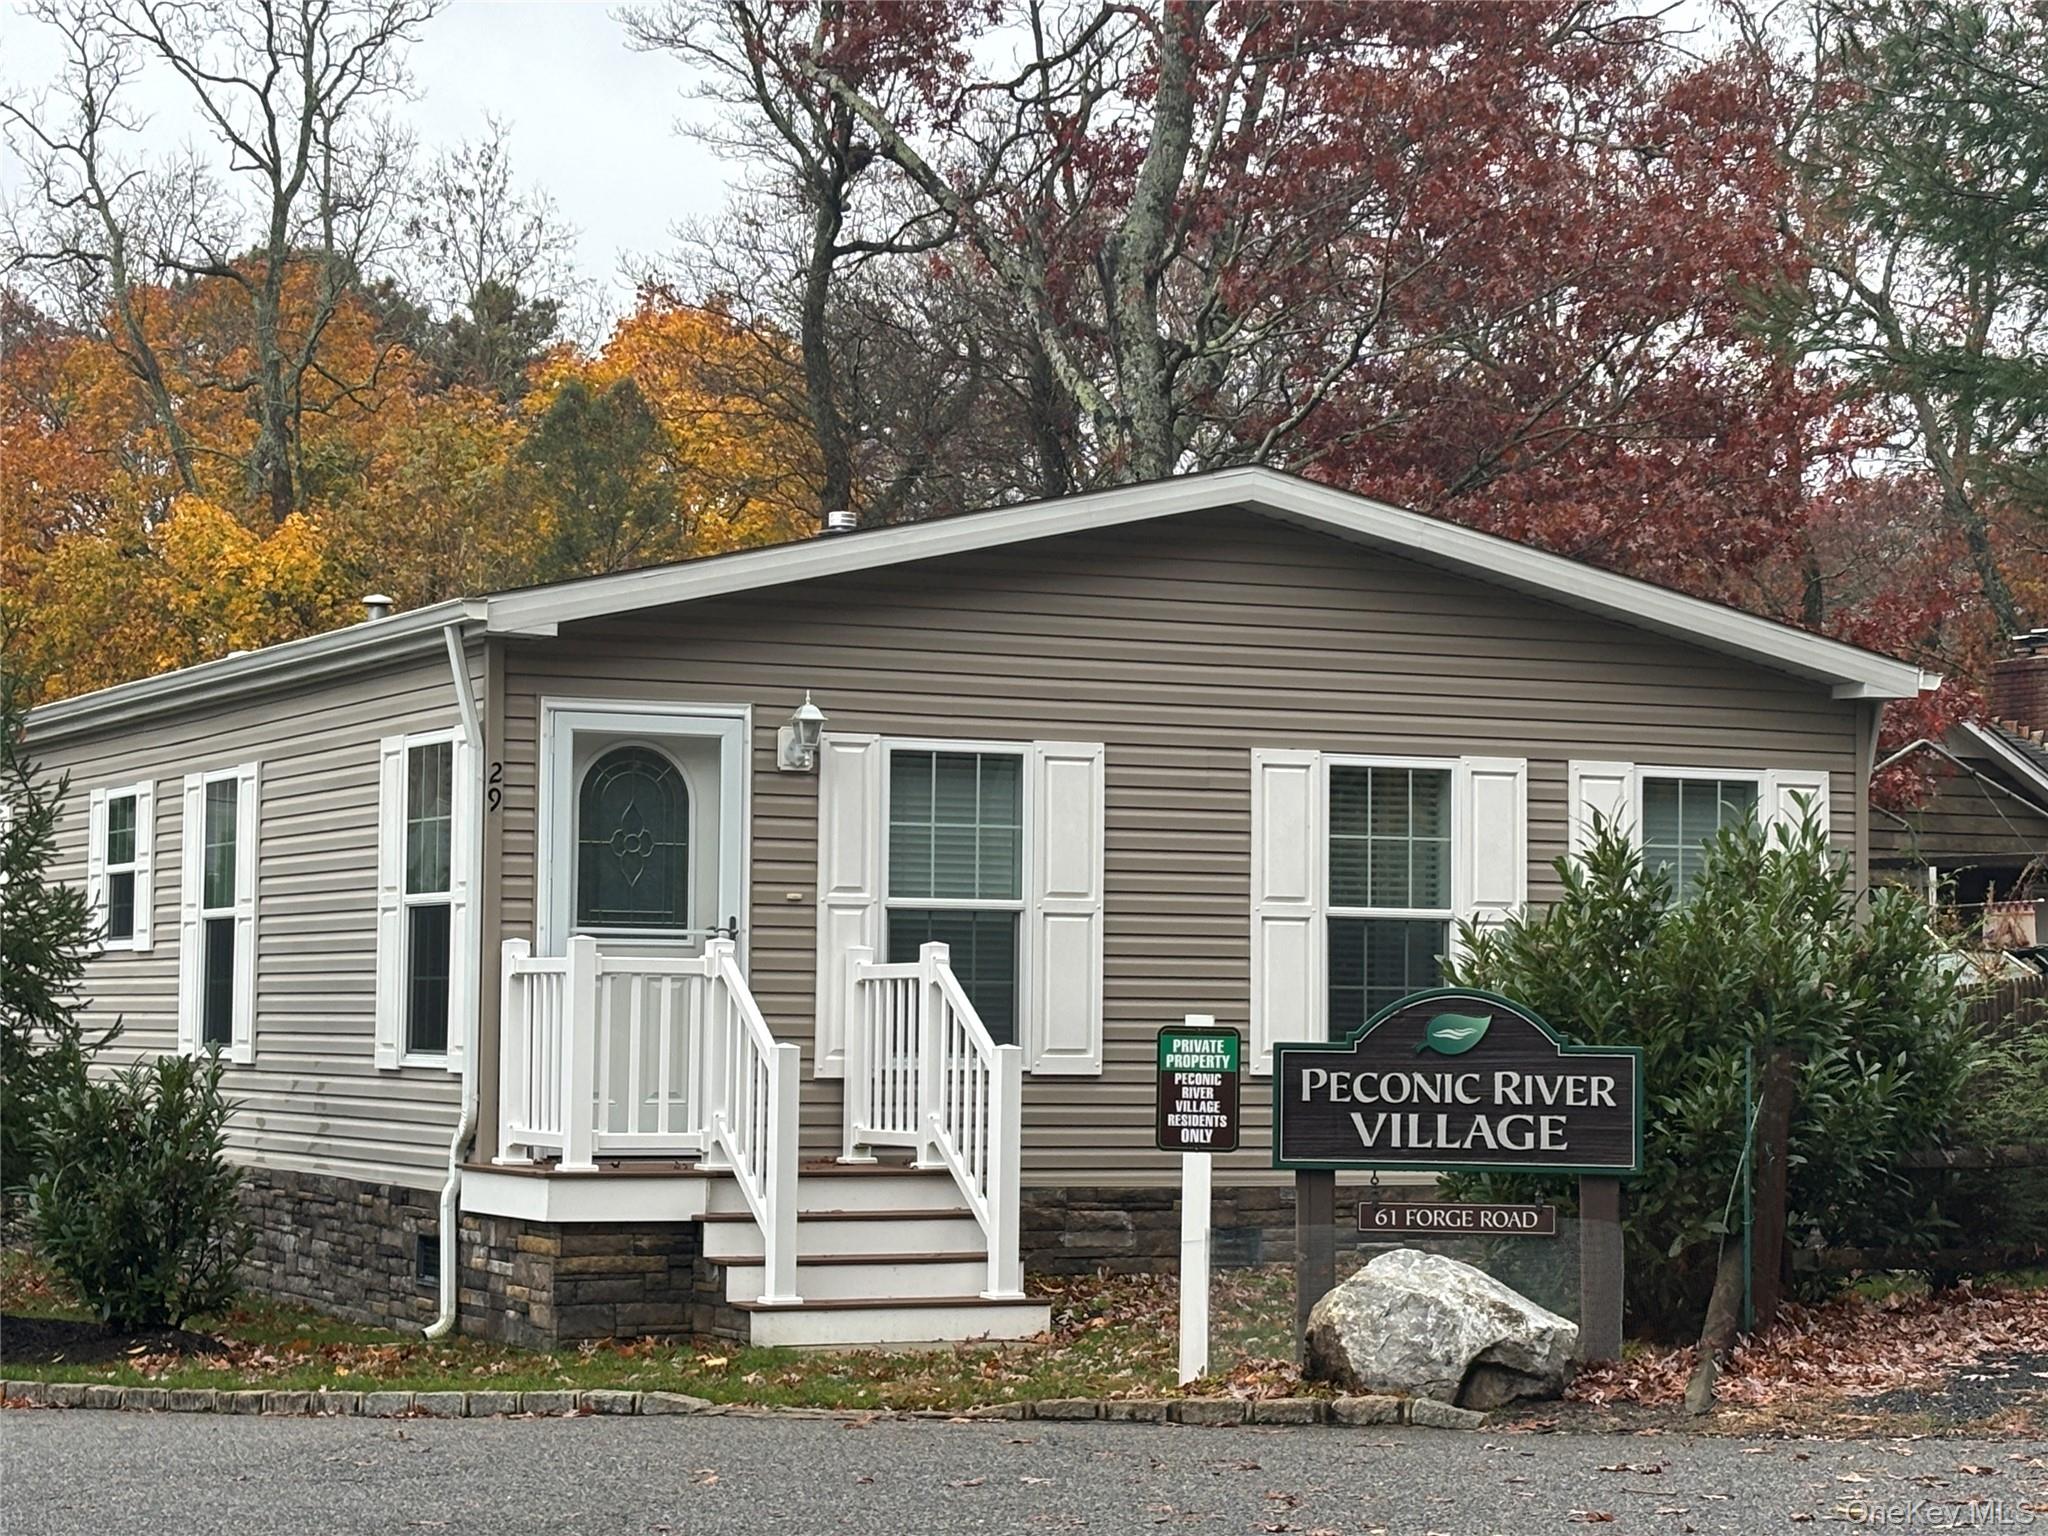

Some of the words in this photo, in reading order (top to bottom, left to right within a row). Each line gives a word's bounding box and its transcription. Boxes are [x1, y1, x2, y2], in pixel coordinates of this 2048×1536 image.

[488, 762, 502, 812] 29
[1172, 1039, 1225, 1054] PRIVATE
[1166, 1054, 1231, 1069] PROPERTY
[1174, 1072, 1222, 1086] PECONIC
[1181, 1087, 1214, 1100] RIVER
[1301, 1068, 1481, 1104] PECONIC
[1494, 1071, 1617, 1107] RIVER
[1175, 1100, 1221, 1113] VILLAGE
[1167, 1114, 1228, 1128] RESIDENTS
[1180, 1128, 1213, 1144] ONLY
[1350, 1112, 1568, 1151] VILLAGE
[1375, 1208, 1397, 1226] 61
[1405, 1208, 1474, 1228] FORGE
[1480, 1210, 1538, 1228] ROAD
